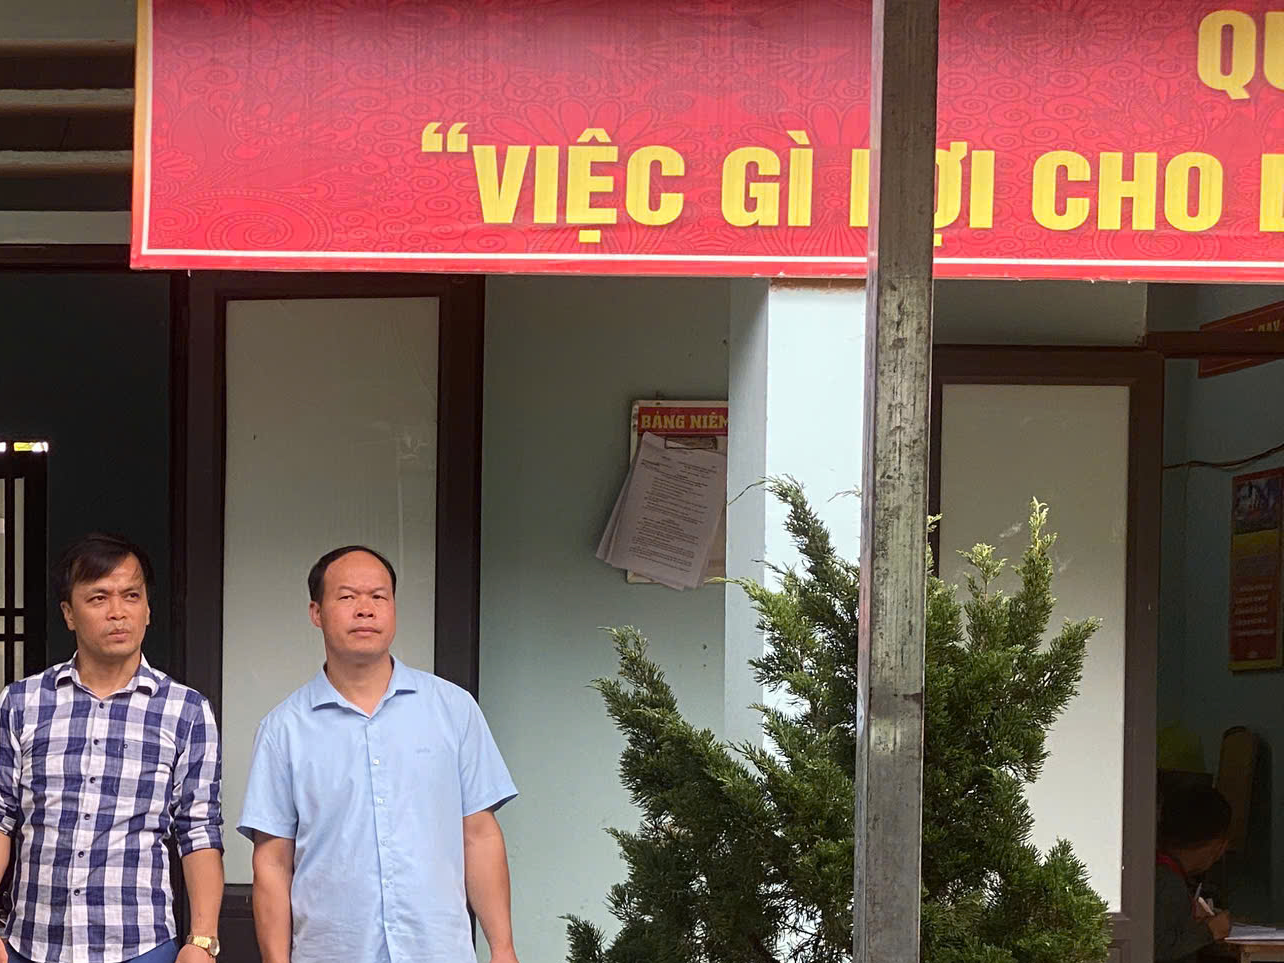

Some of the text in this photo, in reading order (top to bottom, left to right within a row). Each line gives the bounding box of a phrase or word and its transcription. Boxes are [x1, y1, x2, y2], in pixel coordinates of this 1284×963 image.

[721, 130, 814, 228] GÌ
[1031, 150, 1224, 232] CHO
[641, 411, 685, 429] BẢNG
